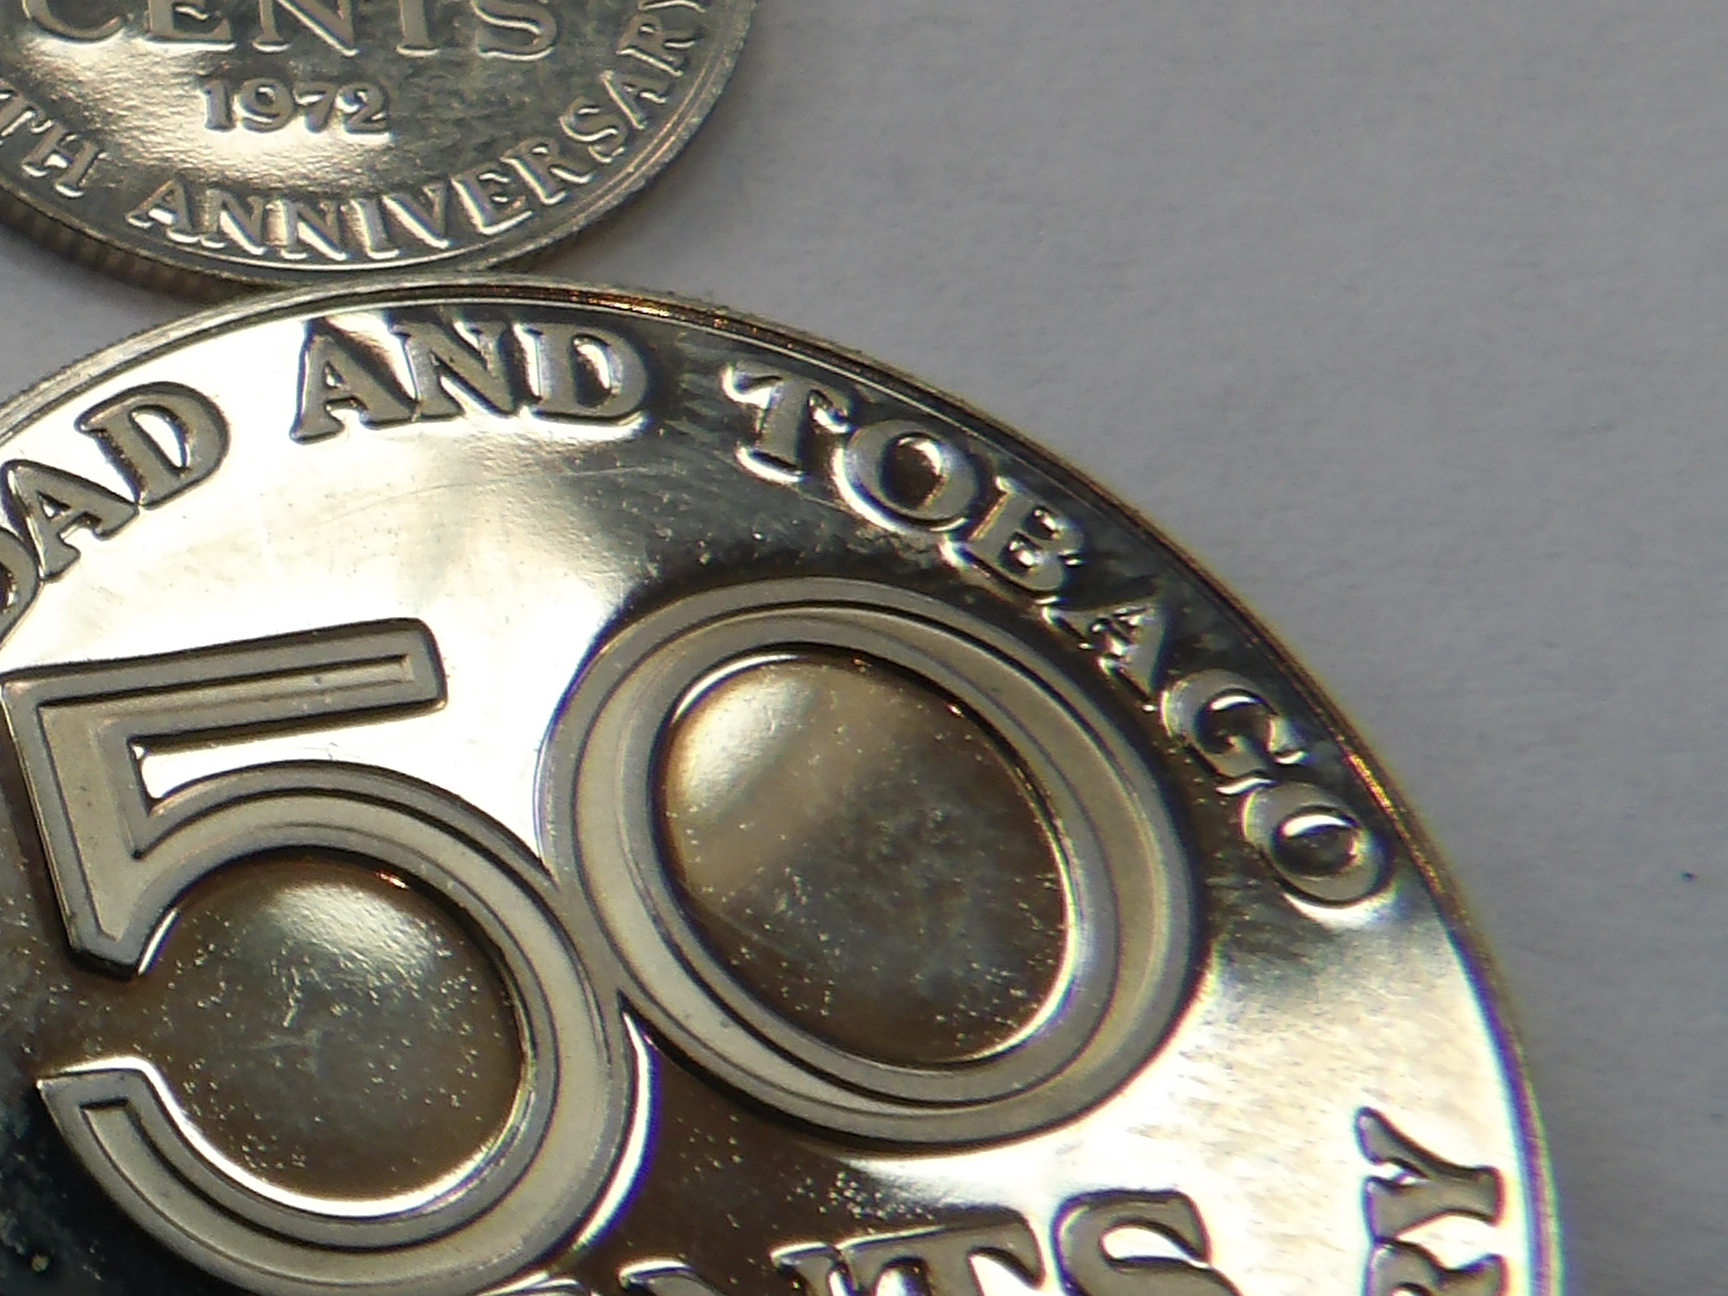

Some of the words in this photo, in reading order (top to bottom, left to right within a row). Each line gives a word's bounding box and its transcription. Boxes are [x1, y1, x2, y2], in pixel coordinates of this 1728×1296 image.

[198, 77, 396, 139] 1972
[289, 310, 653, 444] AND
[723, 361, 1399, 916] TOBAGO
